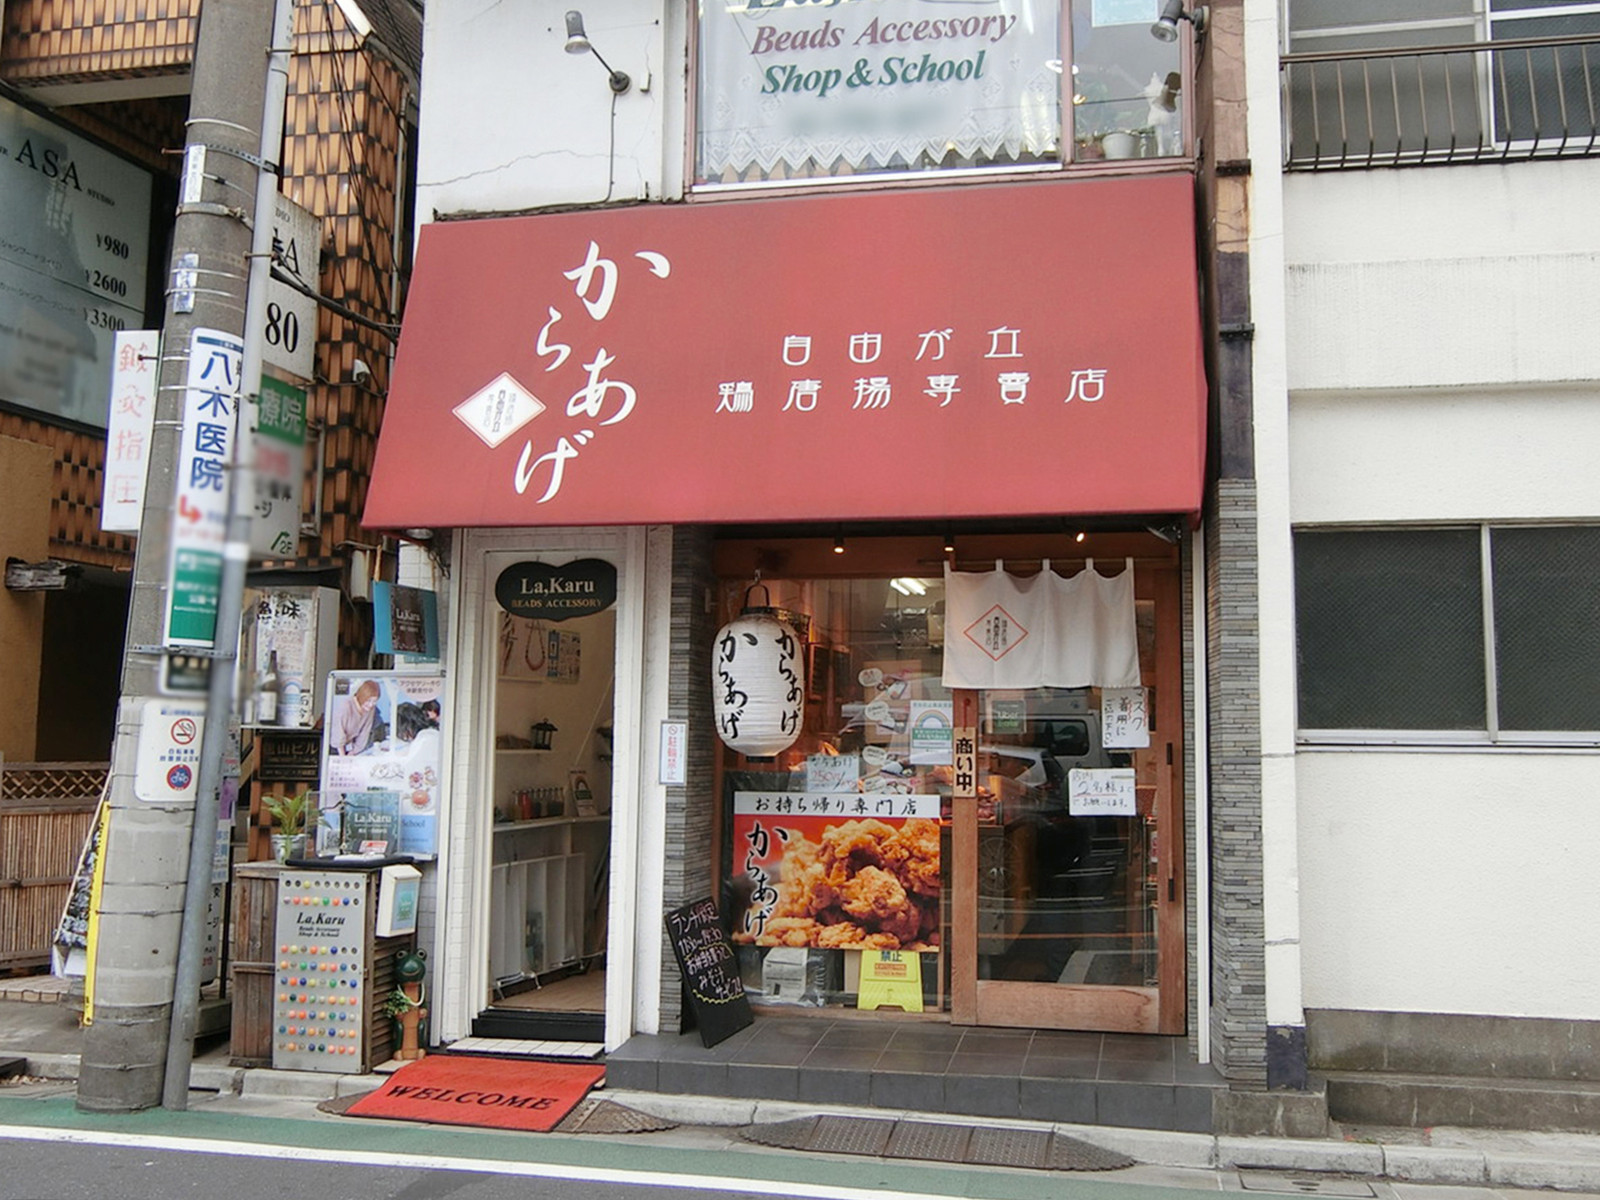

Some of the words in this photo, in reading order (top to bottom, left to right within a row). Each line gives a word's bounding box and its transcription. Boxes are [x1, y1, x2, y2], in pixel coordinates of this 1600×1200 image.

[751, 19, 846, 56] Beads
[853, 12, 1017, 47] Accessory
[761, 63, 842, 98] Shop
[846, 58, 873, 88] &
[878, 49, 987, 86] School
[15, 138, 82, 192] ASA
[513, 240, 671, 504] からあげ
[190, 350, 233, 492] 八木医院
[718, 630, 759, 740] からあげ
[775, 629, 803, 737] からあげ
[955, 737, 974, 792] 商い中
[755, 797, 919, 815] お持ち帰り専門店
[743, 819, 788, 938] からあげ
[386, 1084, 559, 1111] WELCOME
